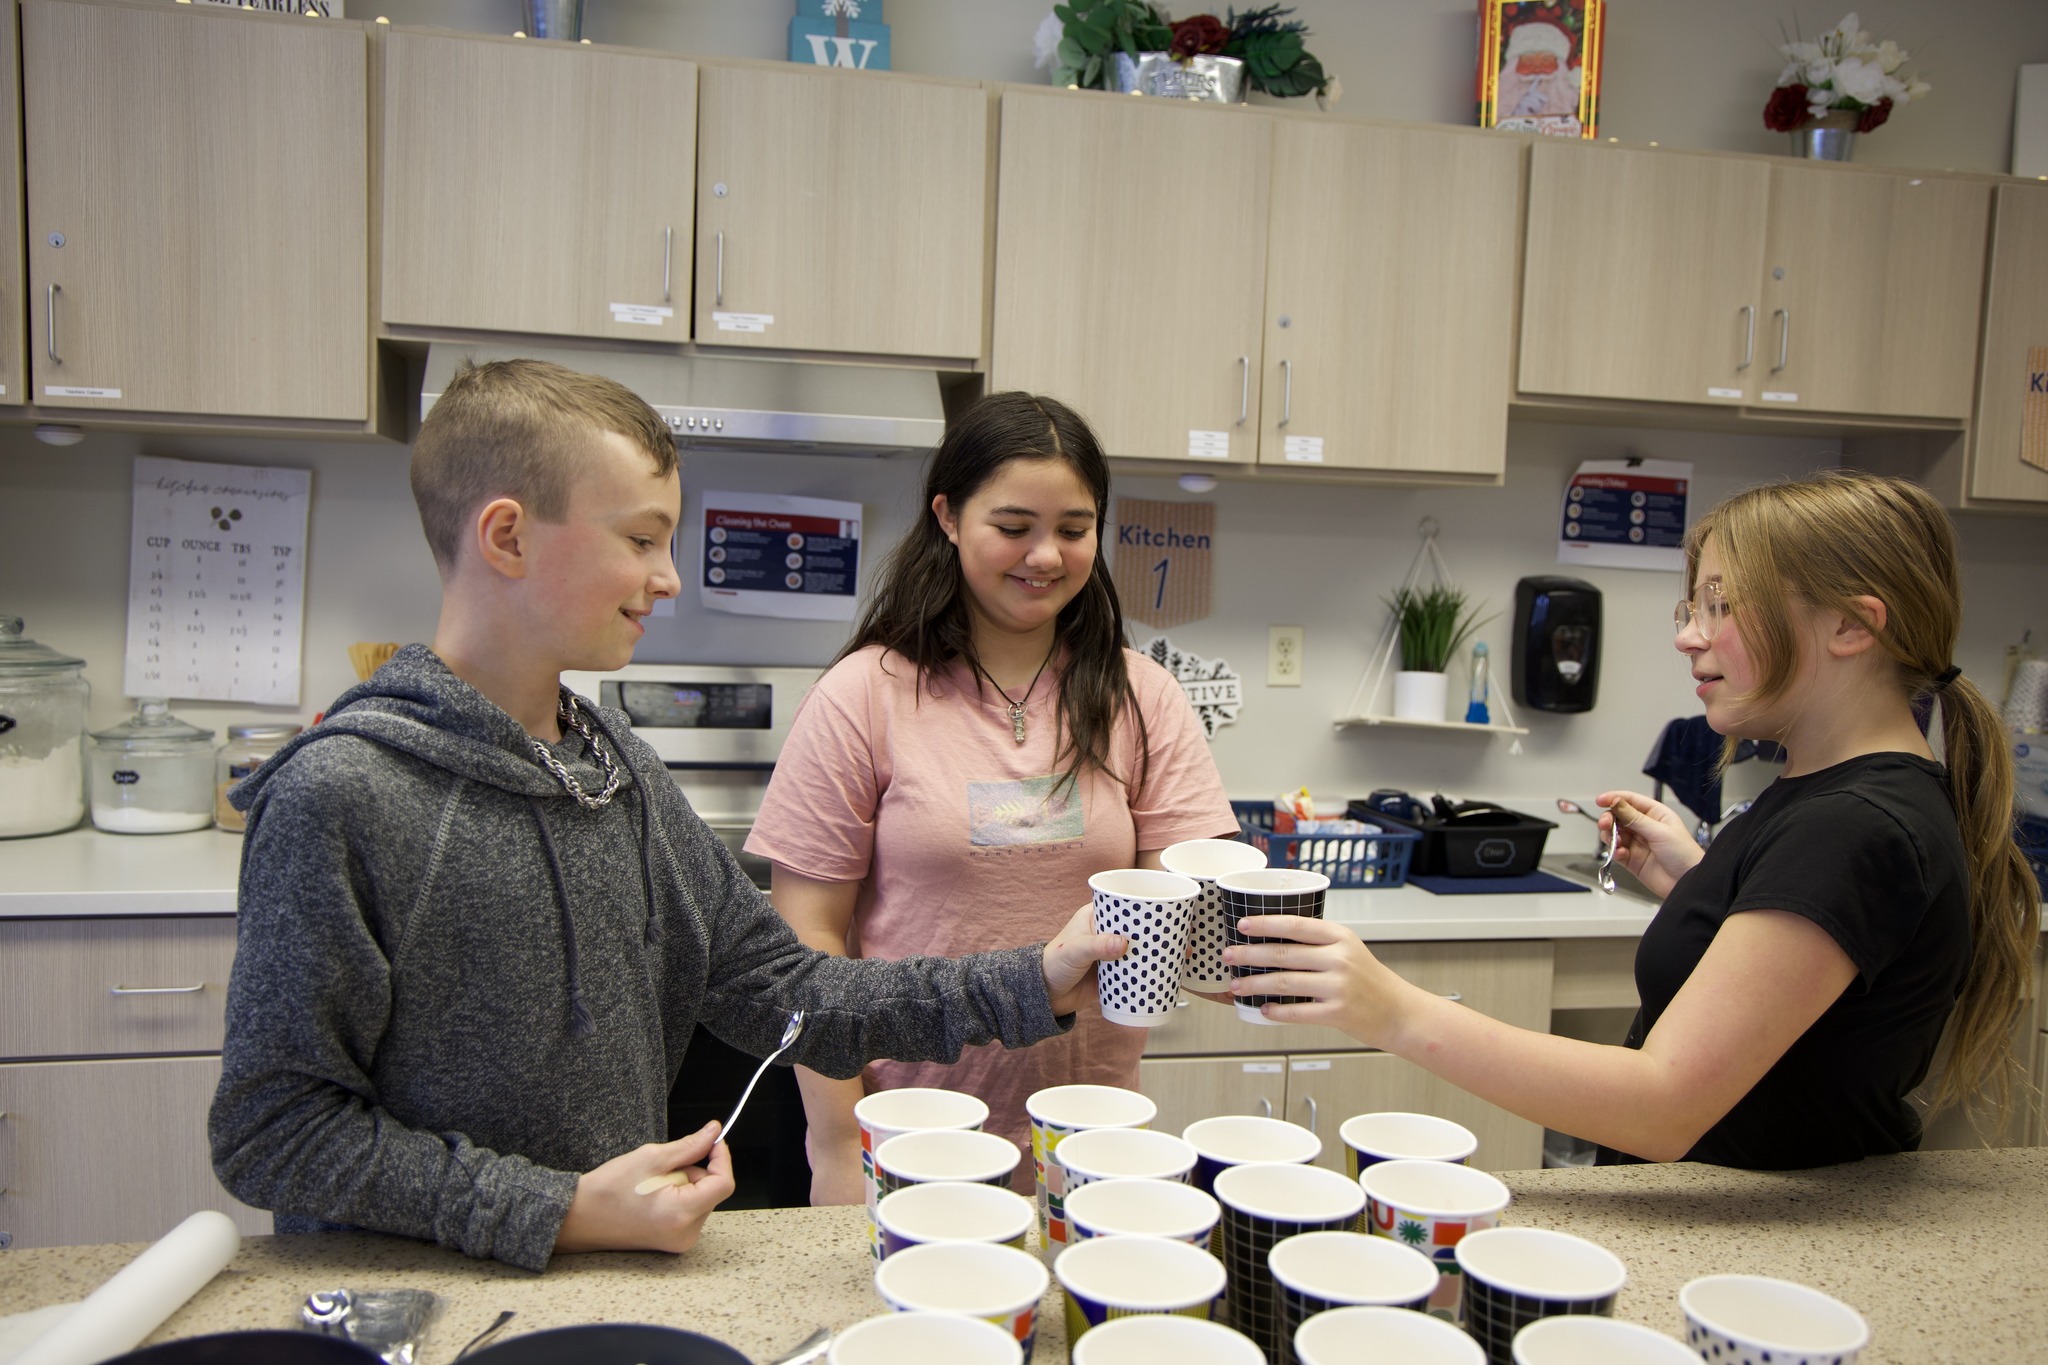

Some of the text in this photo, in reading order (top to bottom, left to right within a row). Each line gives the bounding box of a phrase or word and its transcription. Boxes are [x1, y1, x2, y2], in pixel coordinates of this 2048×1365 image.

[147, 536, 292, 557] CUP OUNCE TBS TSP
[1119, 525, 1211, 549] Kitchen
[1153, 557, 1169, 609] 1
[1187, 685, 1236, 701] TIVE
